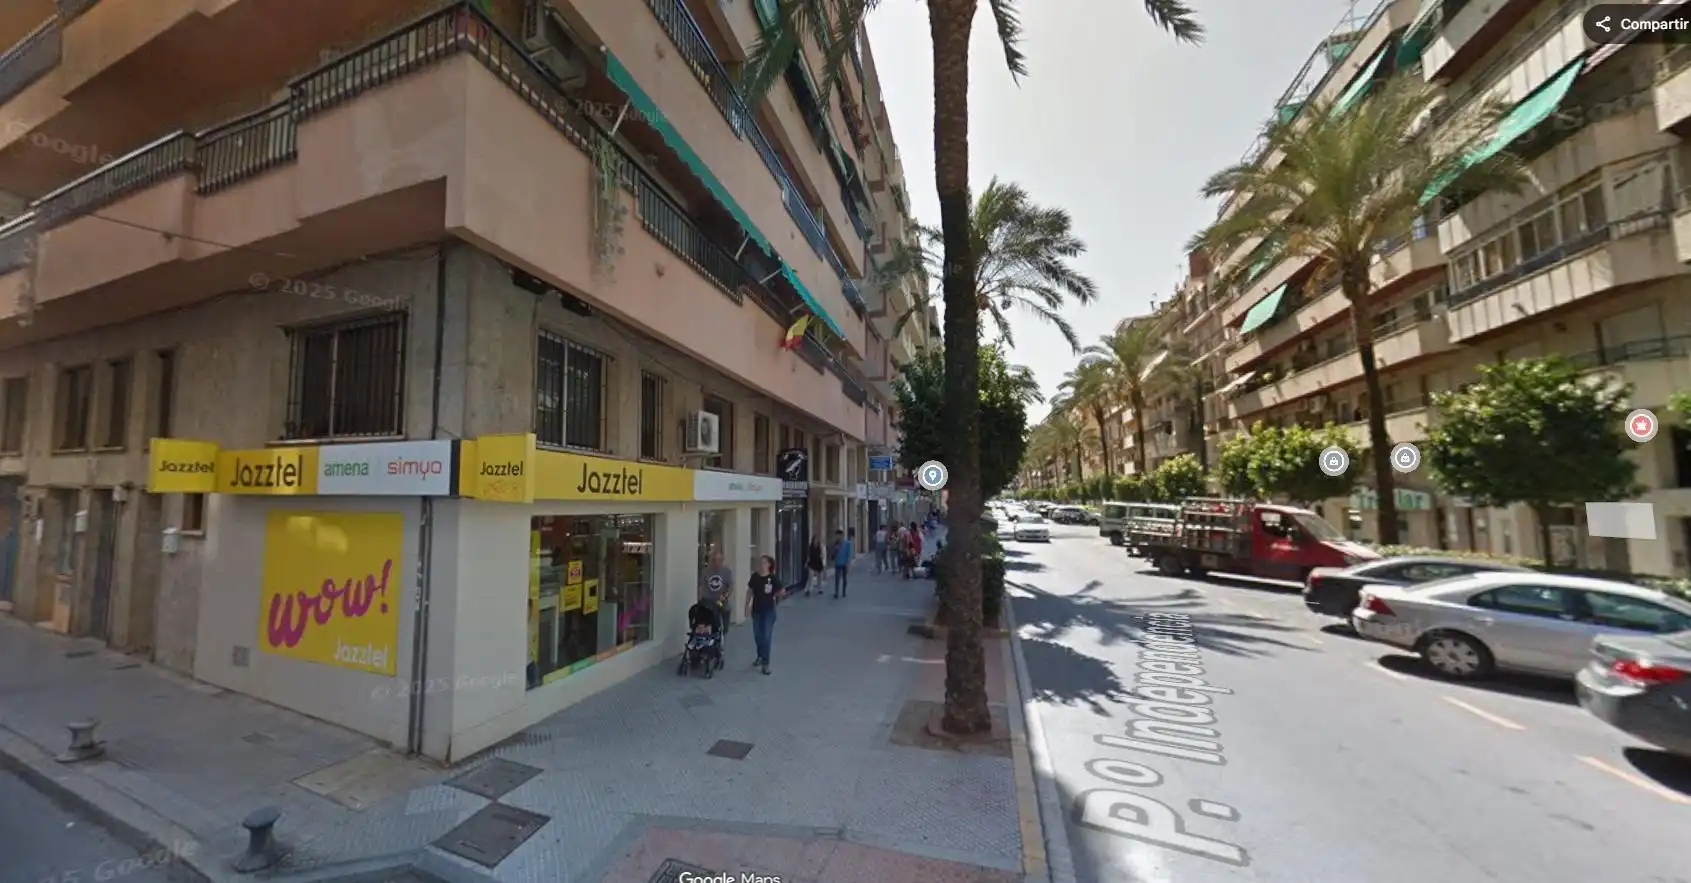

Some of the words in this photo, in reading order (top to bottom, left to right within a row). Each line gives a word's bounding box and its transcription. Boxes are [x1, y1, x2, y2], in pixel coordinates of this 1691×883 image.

[158, 460, 215, 473] Jazztel
[230, 454, 303, 487] Jazztel
[324, 461, 369, 477] amena
[387, 456, 442, 481] simyo
[479, 460, 524, 477] Jazztel
[577, 462, 643, 496] Jazztel
[268, 558, 392, 648] wow!
[334, 636, 388, 669] Jazztel
